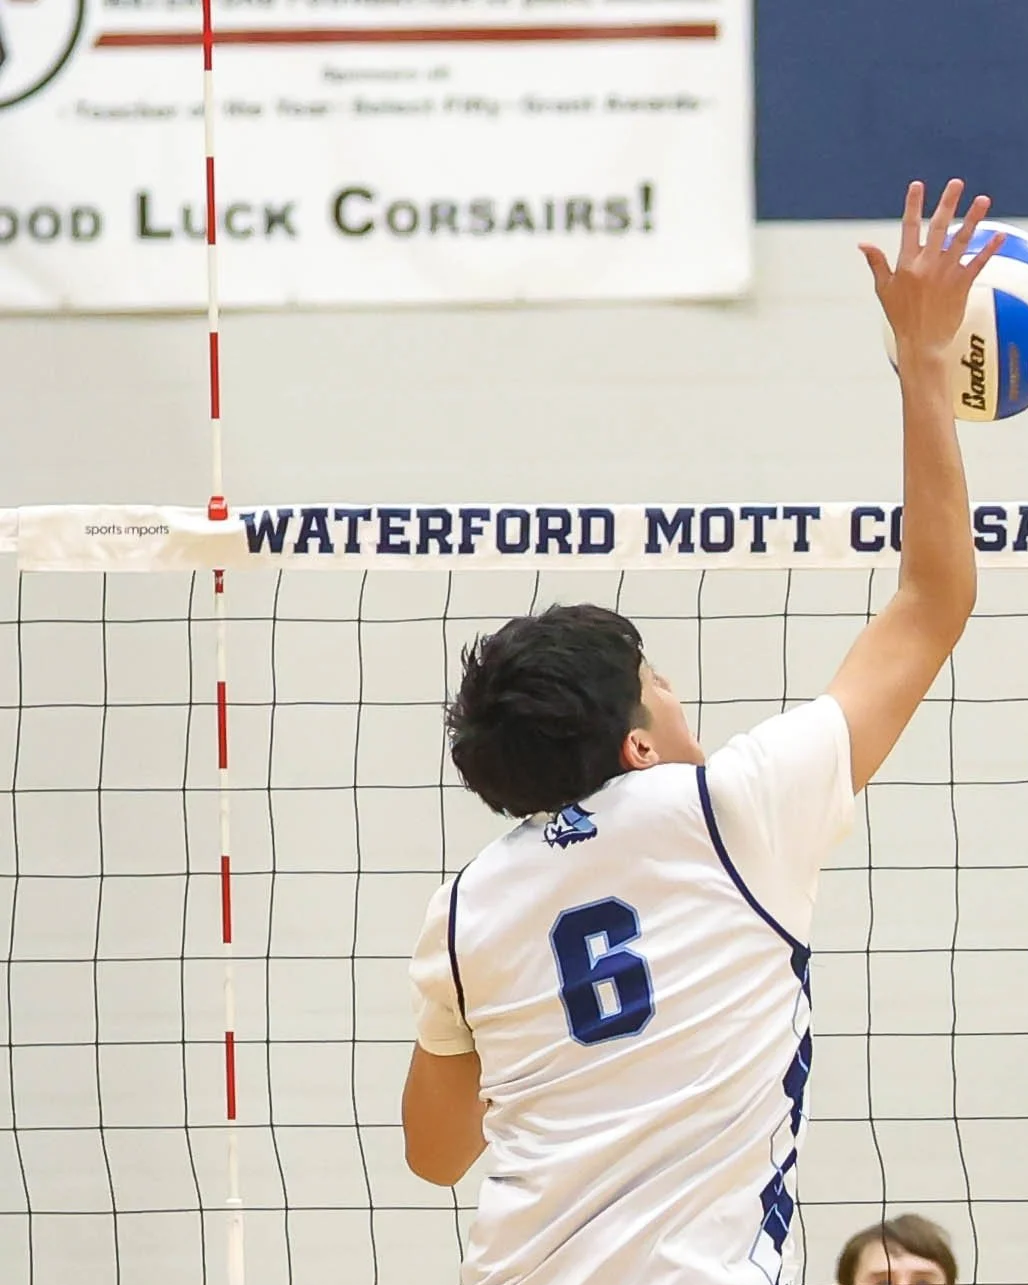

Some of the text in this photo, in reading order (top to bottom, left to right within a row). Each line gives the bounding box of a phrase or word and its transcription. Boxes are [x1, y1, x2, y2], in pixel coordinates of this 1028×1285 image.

[331, 183, 655, 238] CORSAIRS!
[961, 332, 986, 411] Baden
[84, 514, 169, 537] sports imports
[239, 507, 616, 555] WATERFORD
[643, 505, 822, 553] MOTT
[549, 896, 656, 1047] 6
